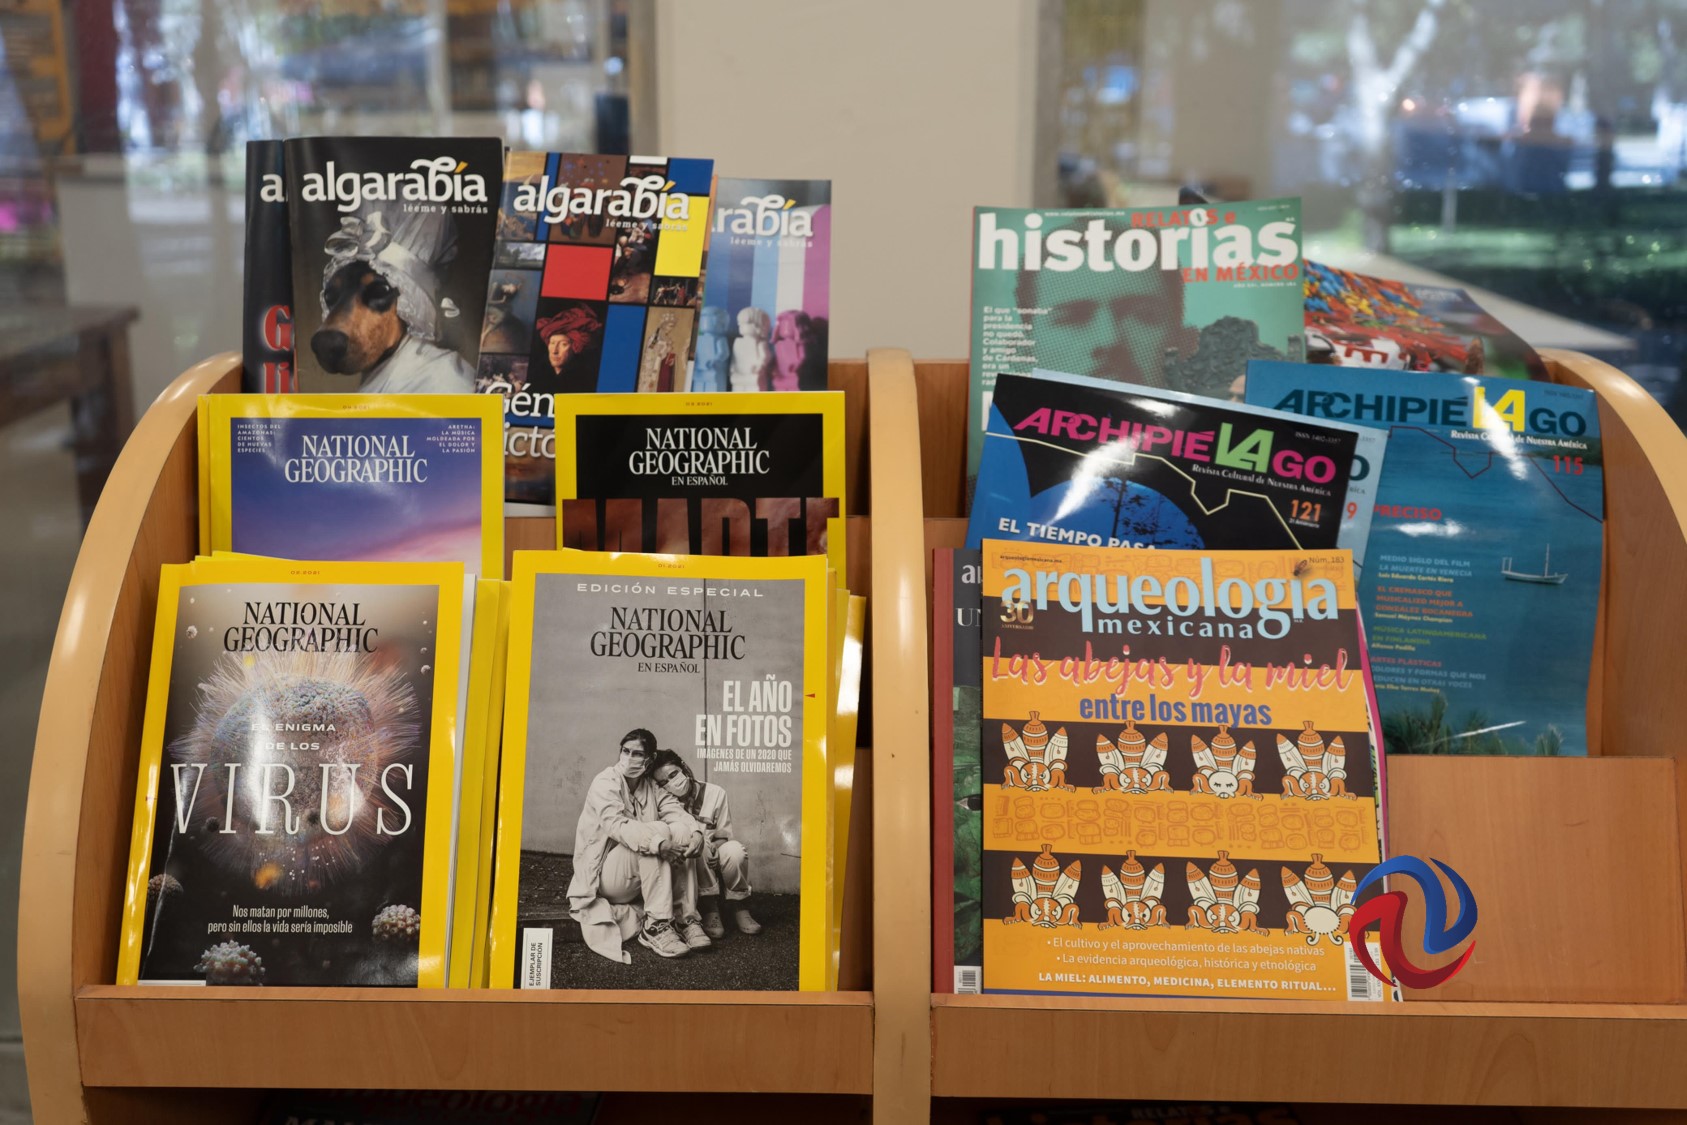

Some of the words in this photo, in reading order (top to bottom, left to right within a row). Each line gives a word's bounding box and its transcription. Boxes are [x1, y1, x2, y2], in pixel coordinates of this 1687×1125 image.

[301, 156, 488, 213] algarabía
[441, 205, 446, 214] y
[513, 175, 690, 225] algarabía
[1131, 208, 1219, 228] RELATOS
[1224, 212, 1236, 225] e
[978, 208, 1299, 272] historias
[1183, 268, 1210, 283] EN
[1215, 262, 1300, 282] MÉXICO
[982, 354, 994, 362] de
[302, 435, 416, 458] NATIONAL
[645, 428, 758, 450] NATIONAL
[1013, 406, 1337, 484] ARCHIPIÉLAGO
[284, 458, 428, 483] GEOGRAPHIC
[628, 450, 770, 475] GEOGRAPHIC
[1553, 454, 1584, 476] 115
[671, 476, 685, 486] EN
[686, 474, 728, 486] ESPAÑOL
[1290, 499, 1322, 522] 121
[998, 517, 1020, 534] EL
[1027, 522, 1102, 547] TIEMPO
[1308, 555, 1330, 564] Núm.
[1380, 554, 1407, 563] MEDIO
[1408, 556, 1432, 565] SIGLO
[1434, 558, 1450, 566] DEL
[1451, 559, 1470, 568] FILM
[576, 582, 656, 594] EDICIÓN
[667, 586, 764, 598] ESPECIAL
[243, 602, 366, 626] NATIONAL
[610, 606, 733, 634] NATIONAL
[1000, 600, 1034, 624] 30
[1097, 615, 1254, 640] mexicana
[223, 626, 379, 653] GEOGRAPHIC
[590, 631, 746, 661] GEOGRAPHIC
[638, 662, 652, 672] EN
[654, 662, 700, 674] ESPAÑOL
[992, 636, 1055, 686] Las
[1059, 640, 1182, 698] abejas
[1187, 657, 1214, 699] y
[1219, 644, 1254, 692] la
[1265, 648, 1355, 692] miel
[723, 680, 744, 712] EL
[748, 674, 792, 712] AÑO
[1080, 694, 1144, 722] entre
[1150, 694, 1186, 722] los
[1191, 700, 1272, 728] mayas
[251, 723, 270, 732] EL
[275, 724, 336, 732] ENIGMA
[695, 714, 722, 746] EN
[726, 714, 792, 748] FOTOS
[264, 742, 287, 750] DE
[290, 742, 320, 751] LOS
[697, 746, 734, 759] IMÁGENES
[736, 748, 744, 760] DE
[746, 749, 756, 760] UN
[758, 749, 776, 760] 2020
[778, 750, 792, 761] QUE
[714, 760, 740, 772] JAMÁS
[740, 762, 792, 773] OLVIDAREMOS
[170, 762, 413, 836] VIRUS
[232, 904, 248, 918] Nos
[250, 906, 276, 918] matan
[277, 908, 292, 919] por
[293, 905, 330, 919] millones,
[208, 922, 228, 934] pero
[228, 920, 241, 932] sin
[242, 920, 262, 932] ellos
[264, 920, 270, 932] la
[272, 921, 289, 932] vida
[314, 920, 353, 934] imposible
[530, 942, 536, 952] DE
[1054, 938, 1063, 948] El
[1065, 938, 1100, 948] cultivo
[1102, 940, 1108, 951] y
[1110, 940, 1120, 950] el
[1122, 940, 1215, 952] aprovechamiento
[1218, 942, 1230, 952] de
[1232, 943, 1248, 954] las
[1250, 944, 1284, 956] abejas
[1286, 945, 1325, 956] nativas
[1062, 954, 1075, 963] La
[1077, 954, 1127, 965] evidencia
[1130, 957, 1202, 969] arqueológica,
[1204, 957, 1250, 968] histórica
[1252, 962, 1258, 971] y
[1260, 960, 1316, 973] etnológica
[1038, 972, 1052, 982] LA
[1055, 973, 1086, 982] MIEL:
[1088, 974, 1151, 987] ALIMENTO,
[1154, 976, 1214, 989] MEDICINA,
[1217, 978, 1278, 989] ELEMENTO
